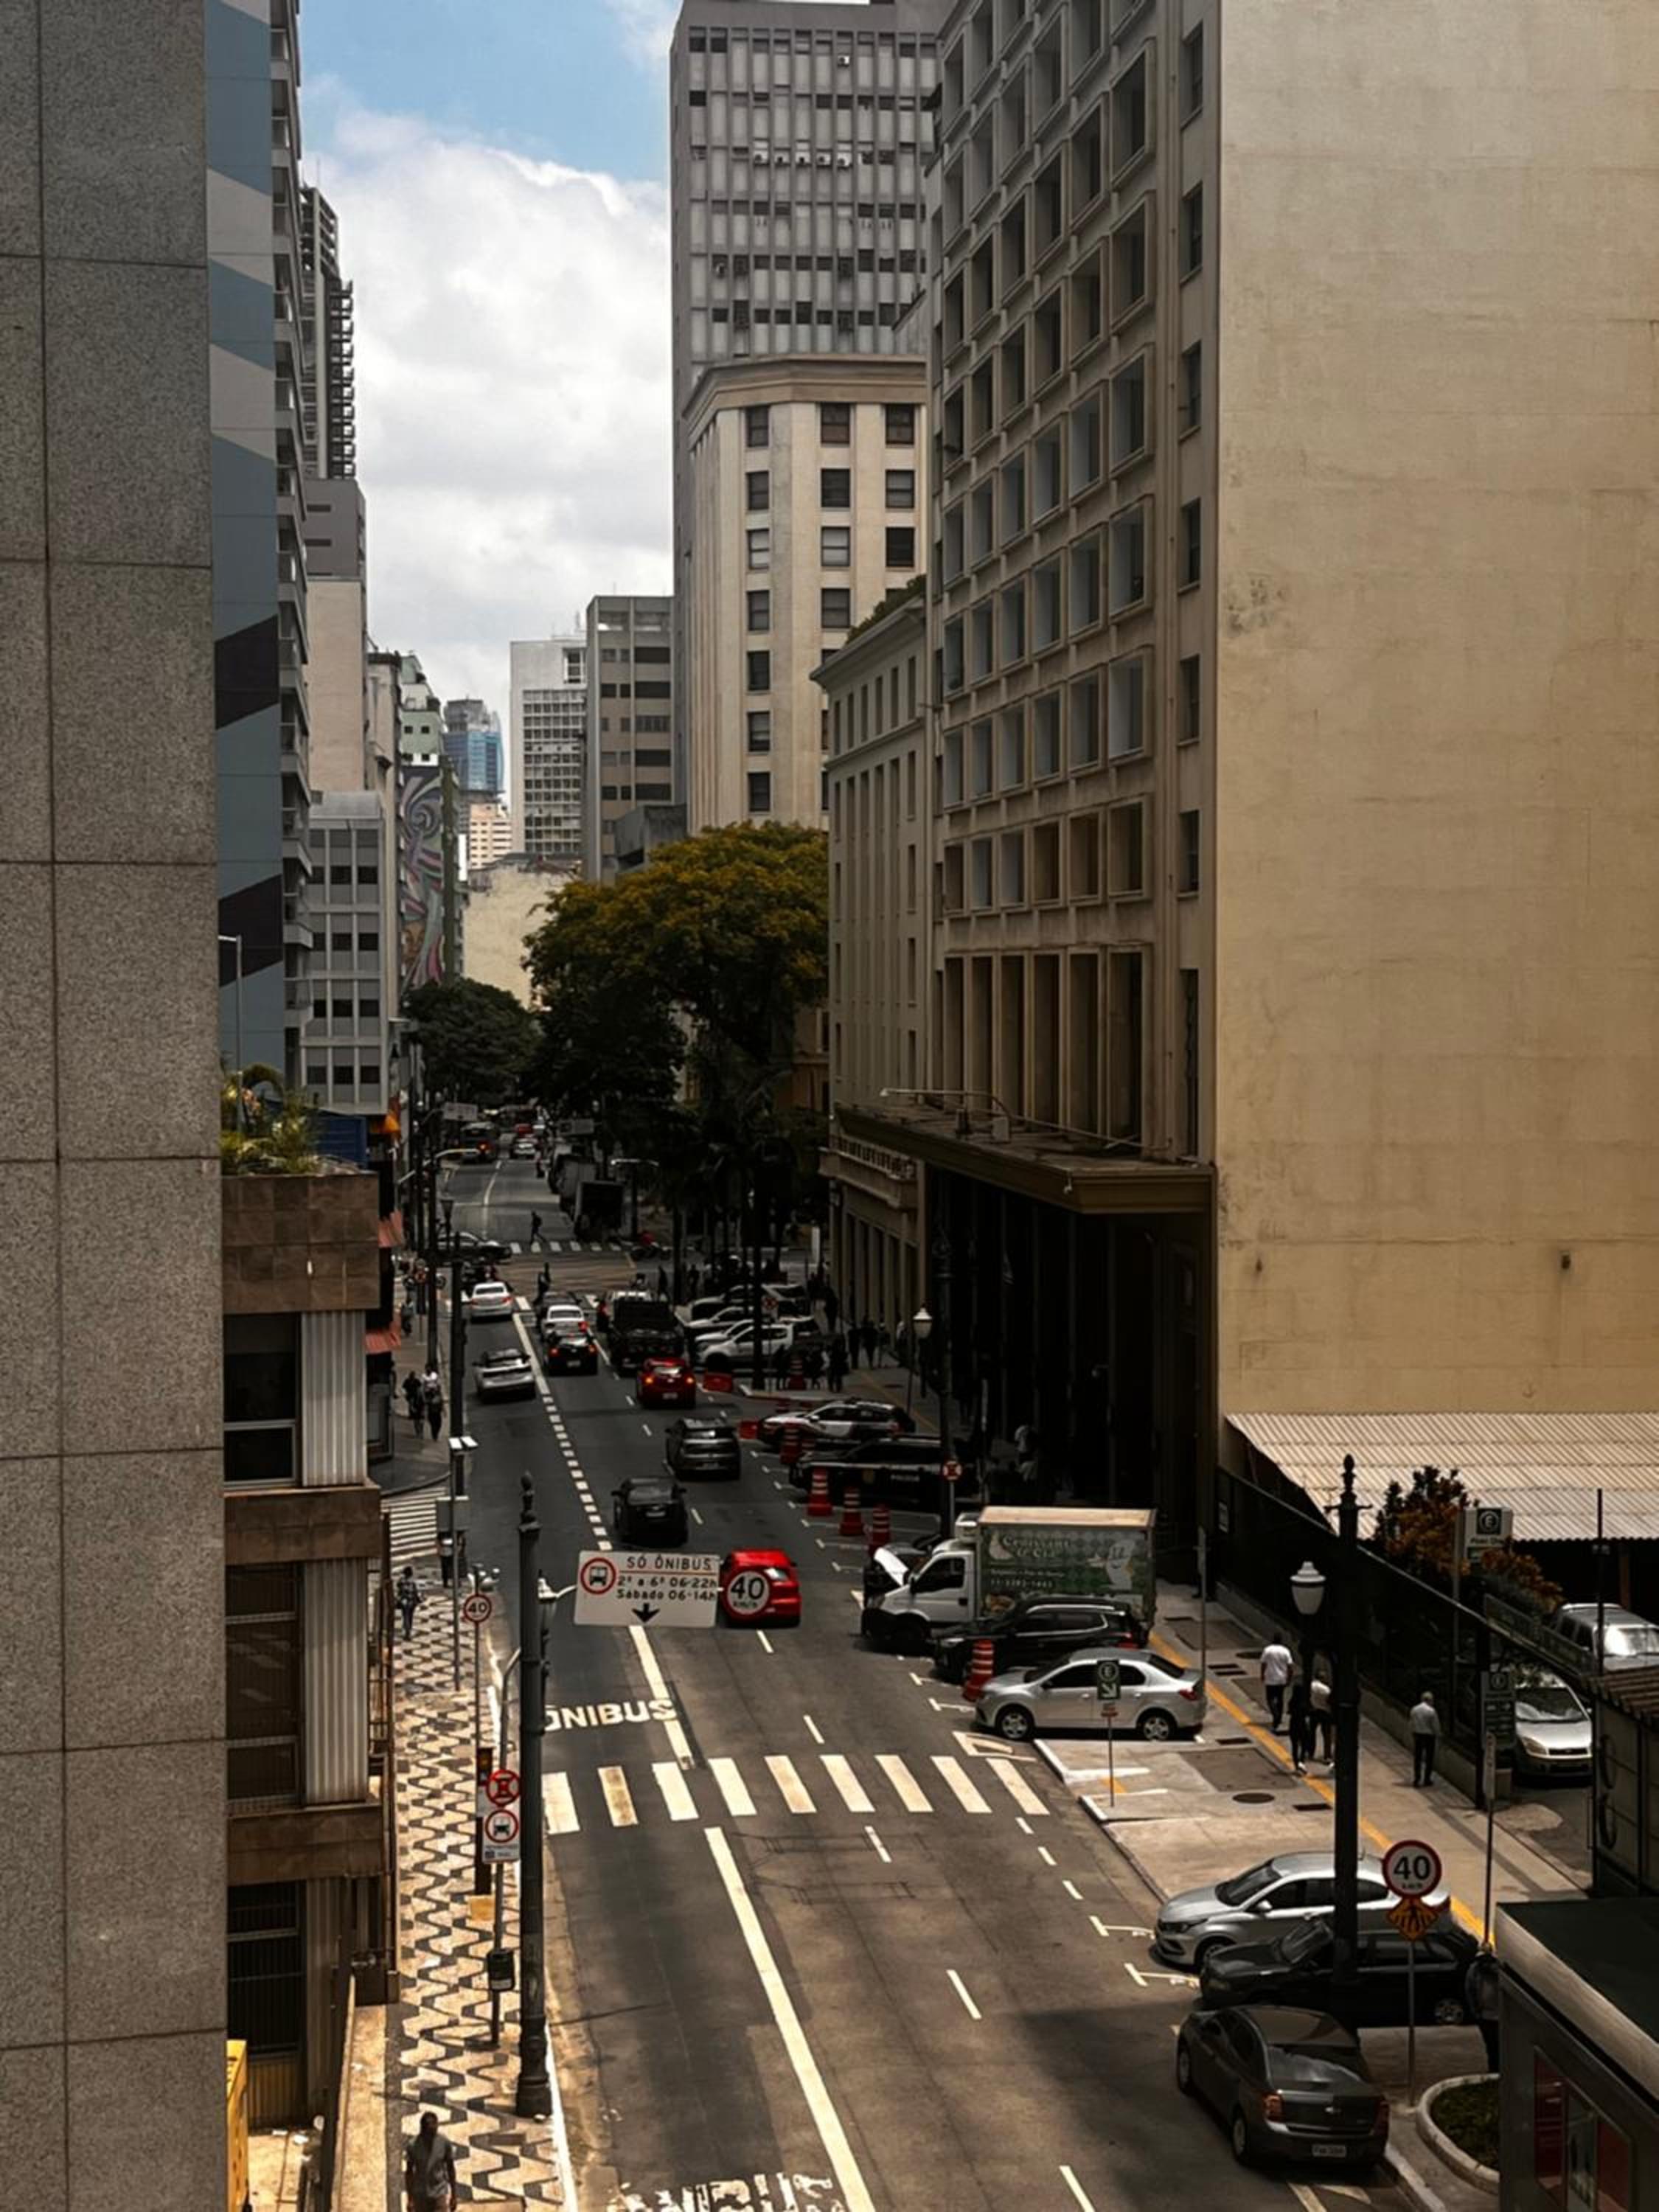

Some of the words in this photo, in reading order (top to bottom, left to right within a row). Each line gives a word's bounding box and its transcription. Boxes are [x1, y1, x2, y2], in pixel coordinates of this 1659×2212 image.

[626, 1554, 648, 1569] SÓ
[654, 1554, 712, 1571] ÔNIBUS
[731, 1576, 765, 1599] 40
[467, 1601, 488, 1614] 40
[1394, 1855, 1431, 1880] 40
